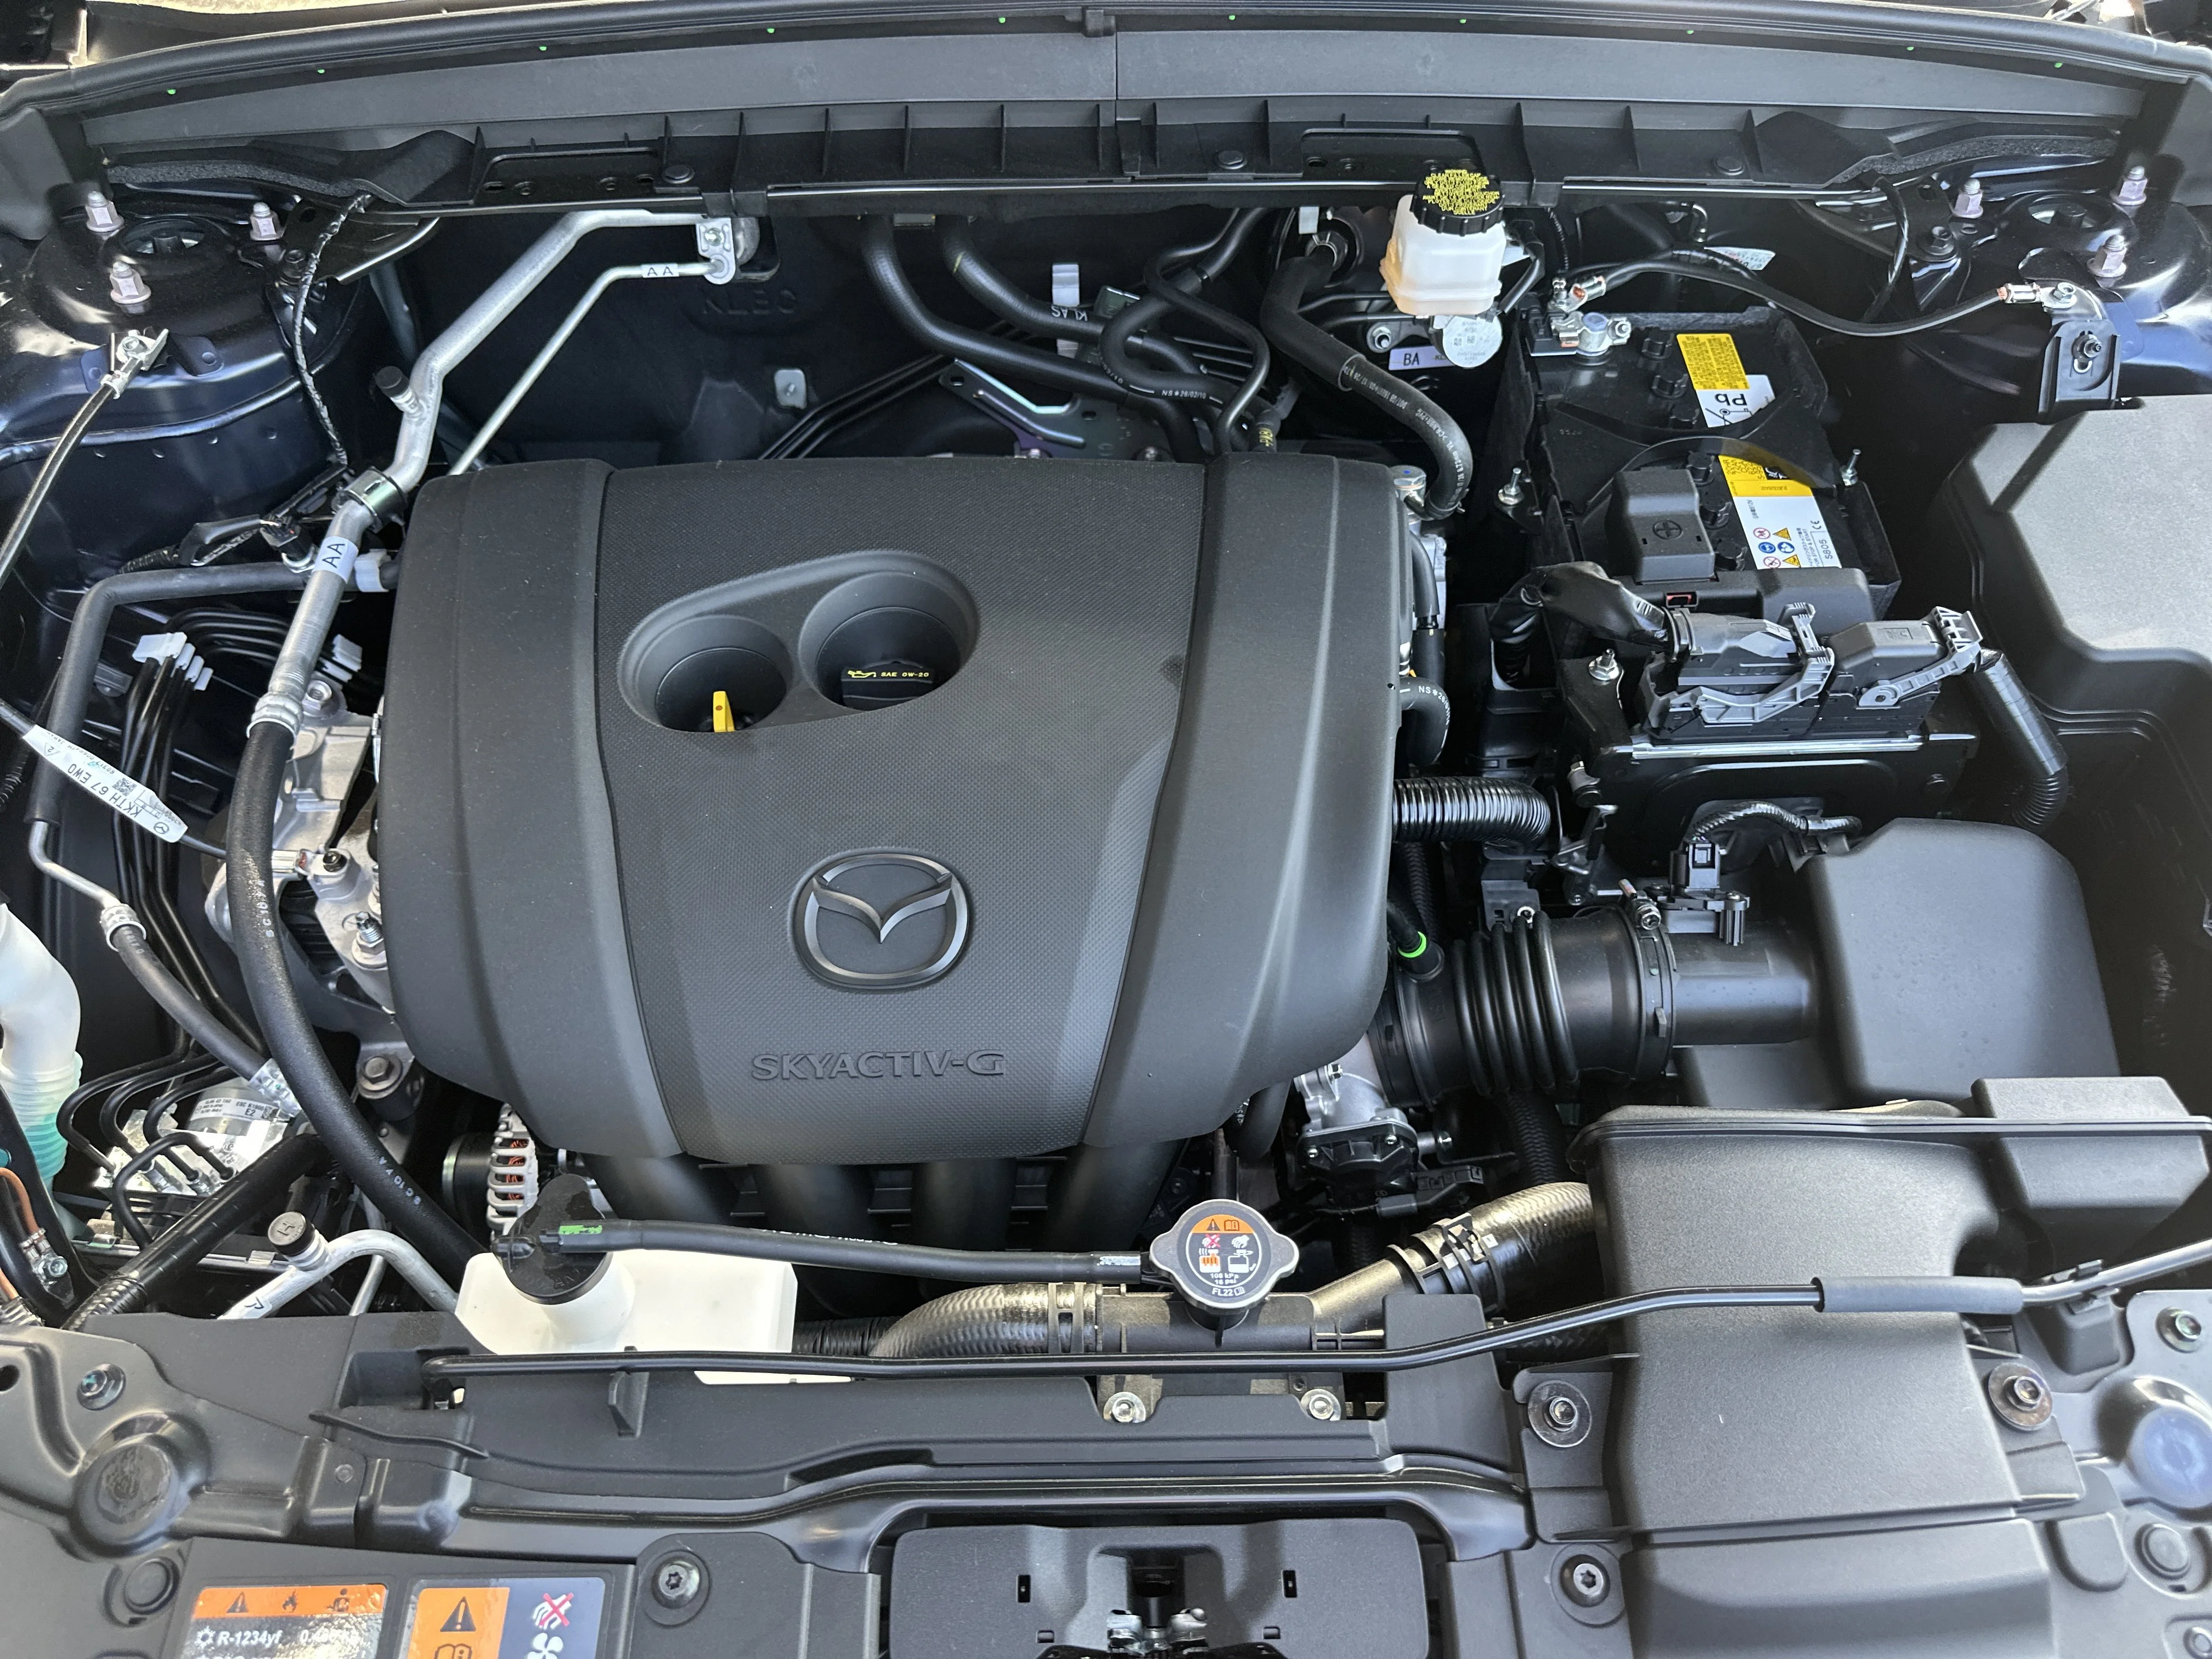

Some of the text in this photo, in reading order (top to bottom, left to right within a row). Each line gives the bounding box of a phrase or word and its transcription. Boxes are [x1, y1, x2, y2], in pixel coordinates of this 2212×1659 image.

[646, 266, 674, 277] AA
[1402, 352, 1419, 366] BA
[1715, 393, 1747, 406] Pb
[322, 543, 345, 568] AA
[1818, 539, 1833, 558] S805
[92, 782, 109, 795] 67
[109, 793, 142, 818] KKTH
[752, 1050, 1005, 1080] SKYACTIV-G
[1212, 1287, 1233, 1296] FL22
[217, 1630, 282, 1647] R-1234yf
